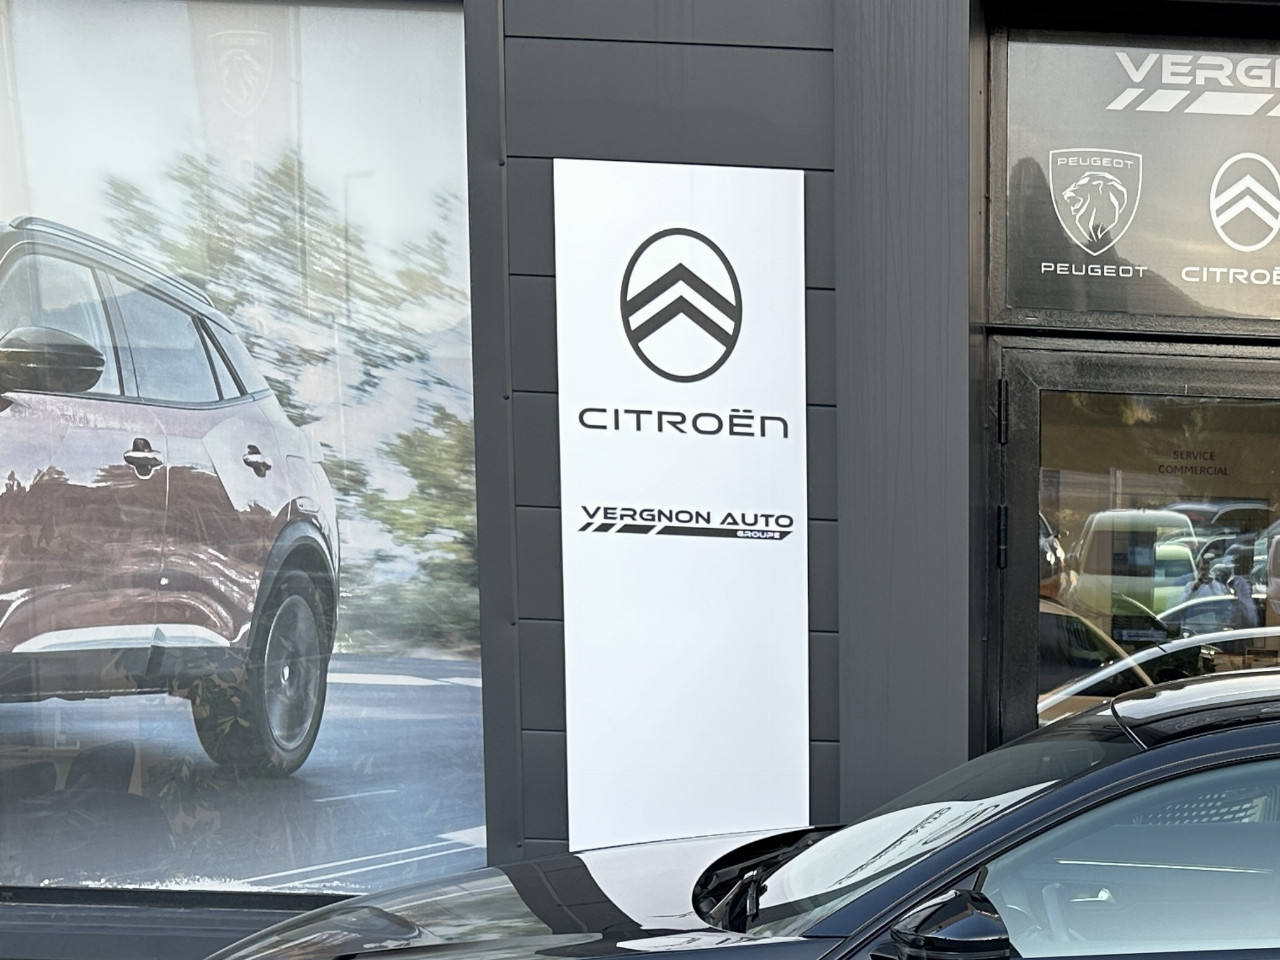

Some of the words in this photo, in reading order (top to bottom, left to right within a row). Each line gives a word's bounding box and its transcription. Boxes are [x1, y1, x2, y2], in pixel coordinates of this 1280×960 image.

[1057, 156, 1135, 170] PEUGEOT
[1041, 262, 1148, 278] PEUGEOT
[578, 407, 789, 439] CITROËN
[1173, 451, 1215, 461] SERVICE
[1158, 464, 1229, 476] COMMERCIAL
[581, 506, 711, 525] VERGNON
[720, 511, 794, 528] AUTO
[736, 530, 781, 539] GROUPE
